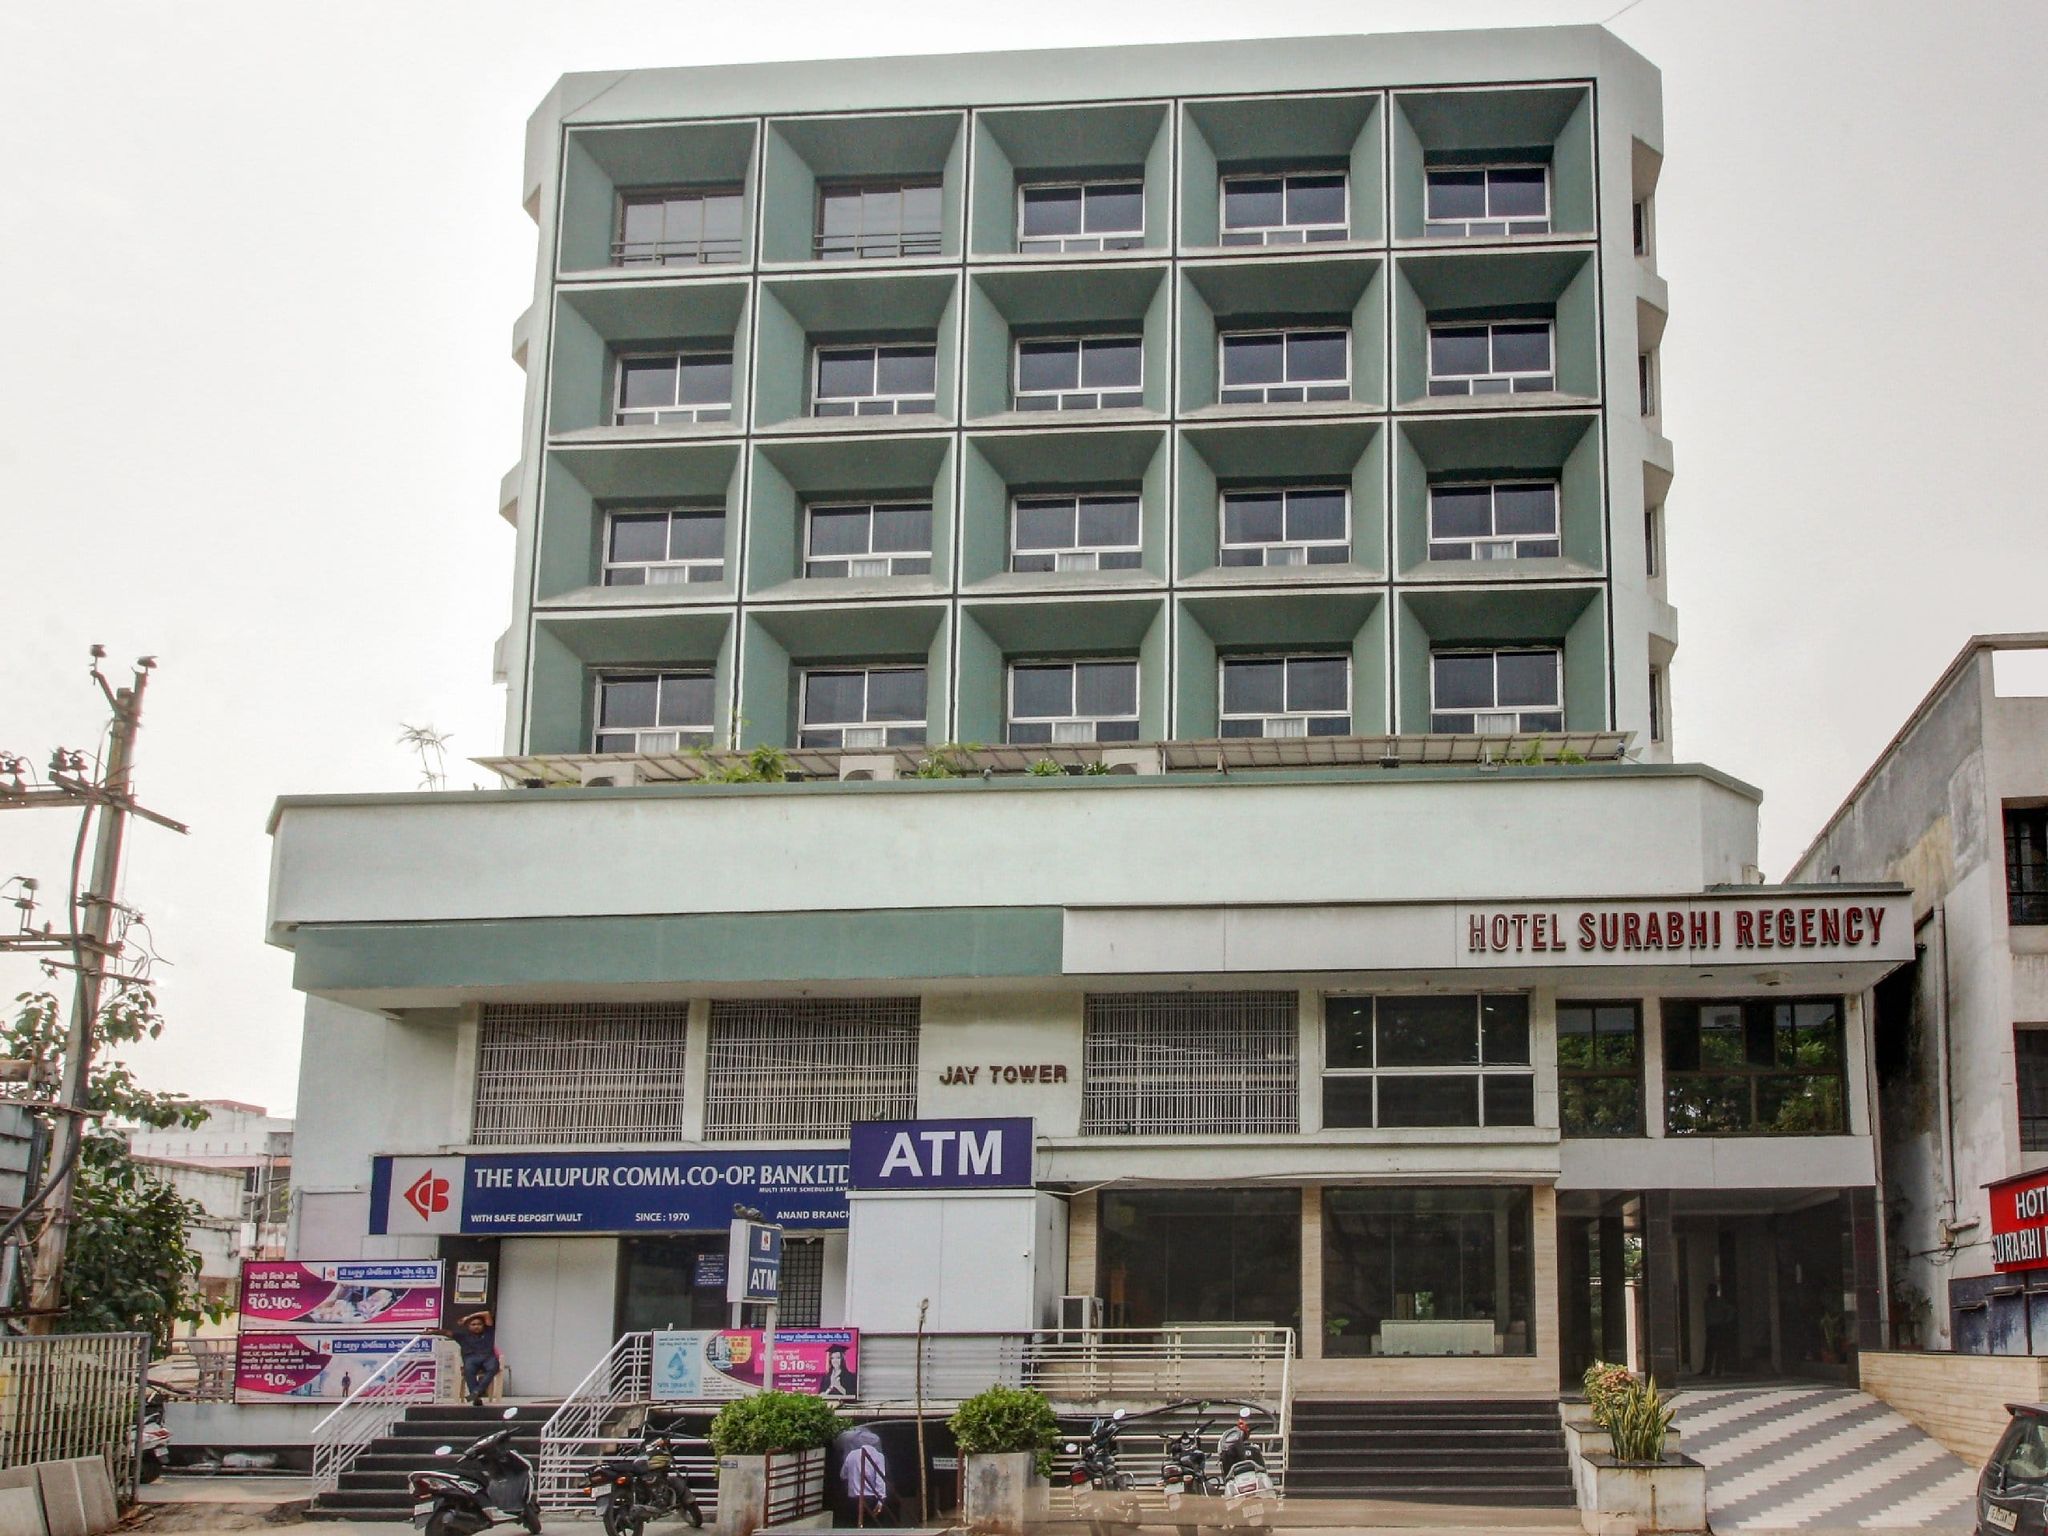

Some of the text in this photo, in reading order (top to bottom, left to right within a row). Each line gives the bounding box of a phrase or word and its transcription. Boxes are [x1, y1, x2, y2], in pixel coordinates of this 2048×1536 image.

[1469, 907, 1886, 951] HOTEL SURABHI REGENCY
[939, 1064, 1067, 1085] JAY TOWER
[879, 1130, 1003, 1177] ATM
[474, 1168, 513, 1188] THE
[516, 1167, 609, 1188] KALUPUR
[760, 1165, 815, 1185] BANK
[2015, 1185, 2048, 1220] HOT
[471, 1213, 583, 1222] WITH SAFE DEPOSIT VAULT
[668, 1213, 690, 1222] 1970
[776, 1211, 810, 1219] ANAND
[1991, 1227, 2041, 1265] SURABHI
[750, 1268, 777, 1291] ATM
